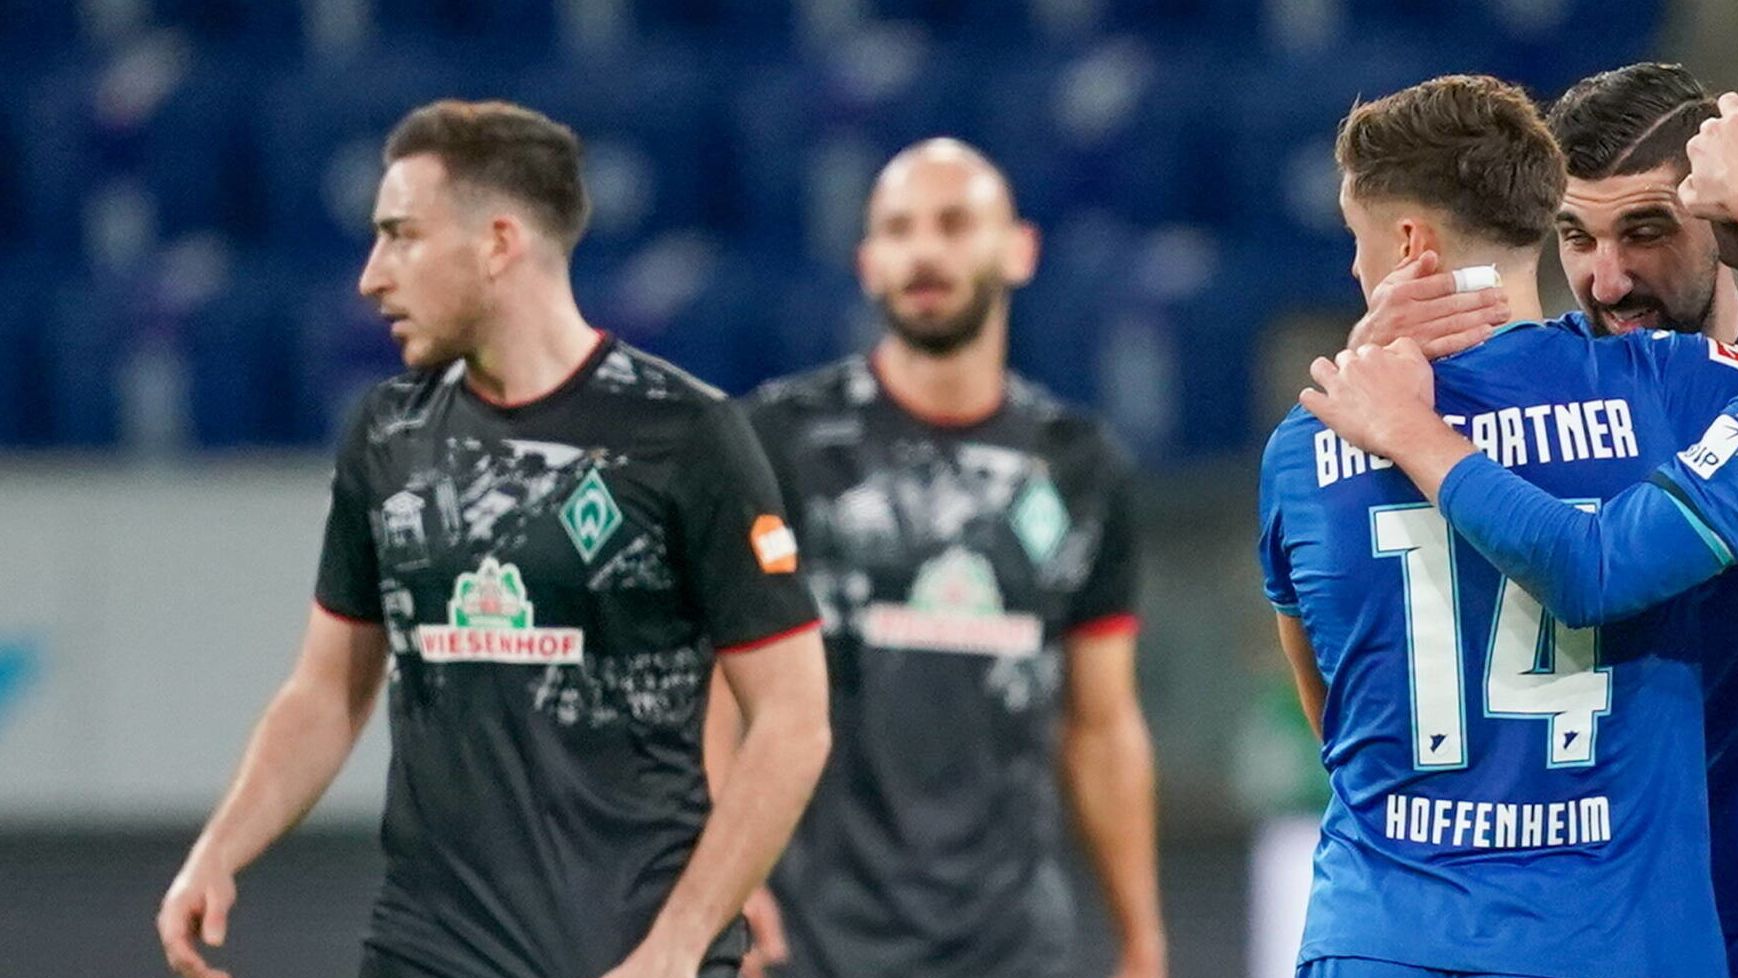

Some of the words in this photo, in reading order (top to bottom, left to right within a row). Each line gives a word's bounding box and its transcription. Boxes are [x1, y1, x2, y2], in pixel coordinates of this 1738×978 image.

[1314, 399, 1638, 488] BAARTNER
[422, 629, 574, 657] WIESENHOF
[1369, 497, 1613, 771] 14
[1385, 794, 1611, 848] HOFFENHEIM
